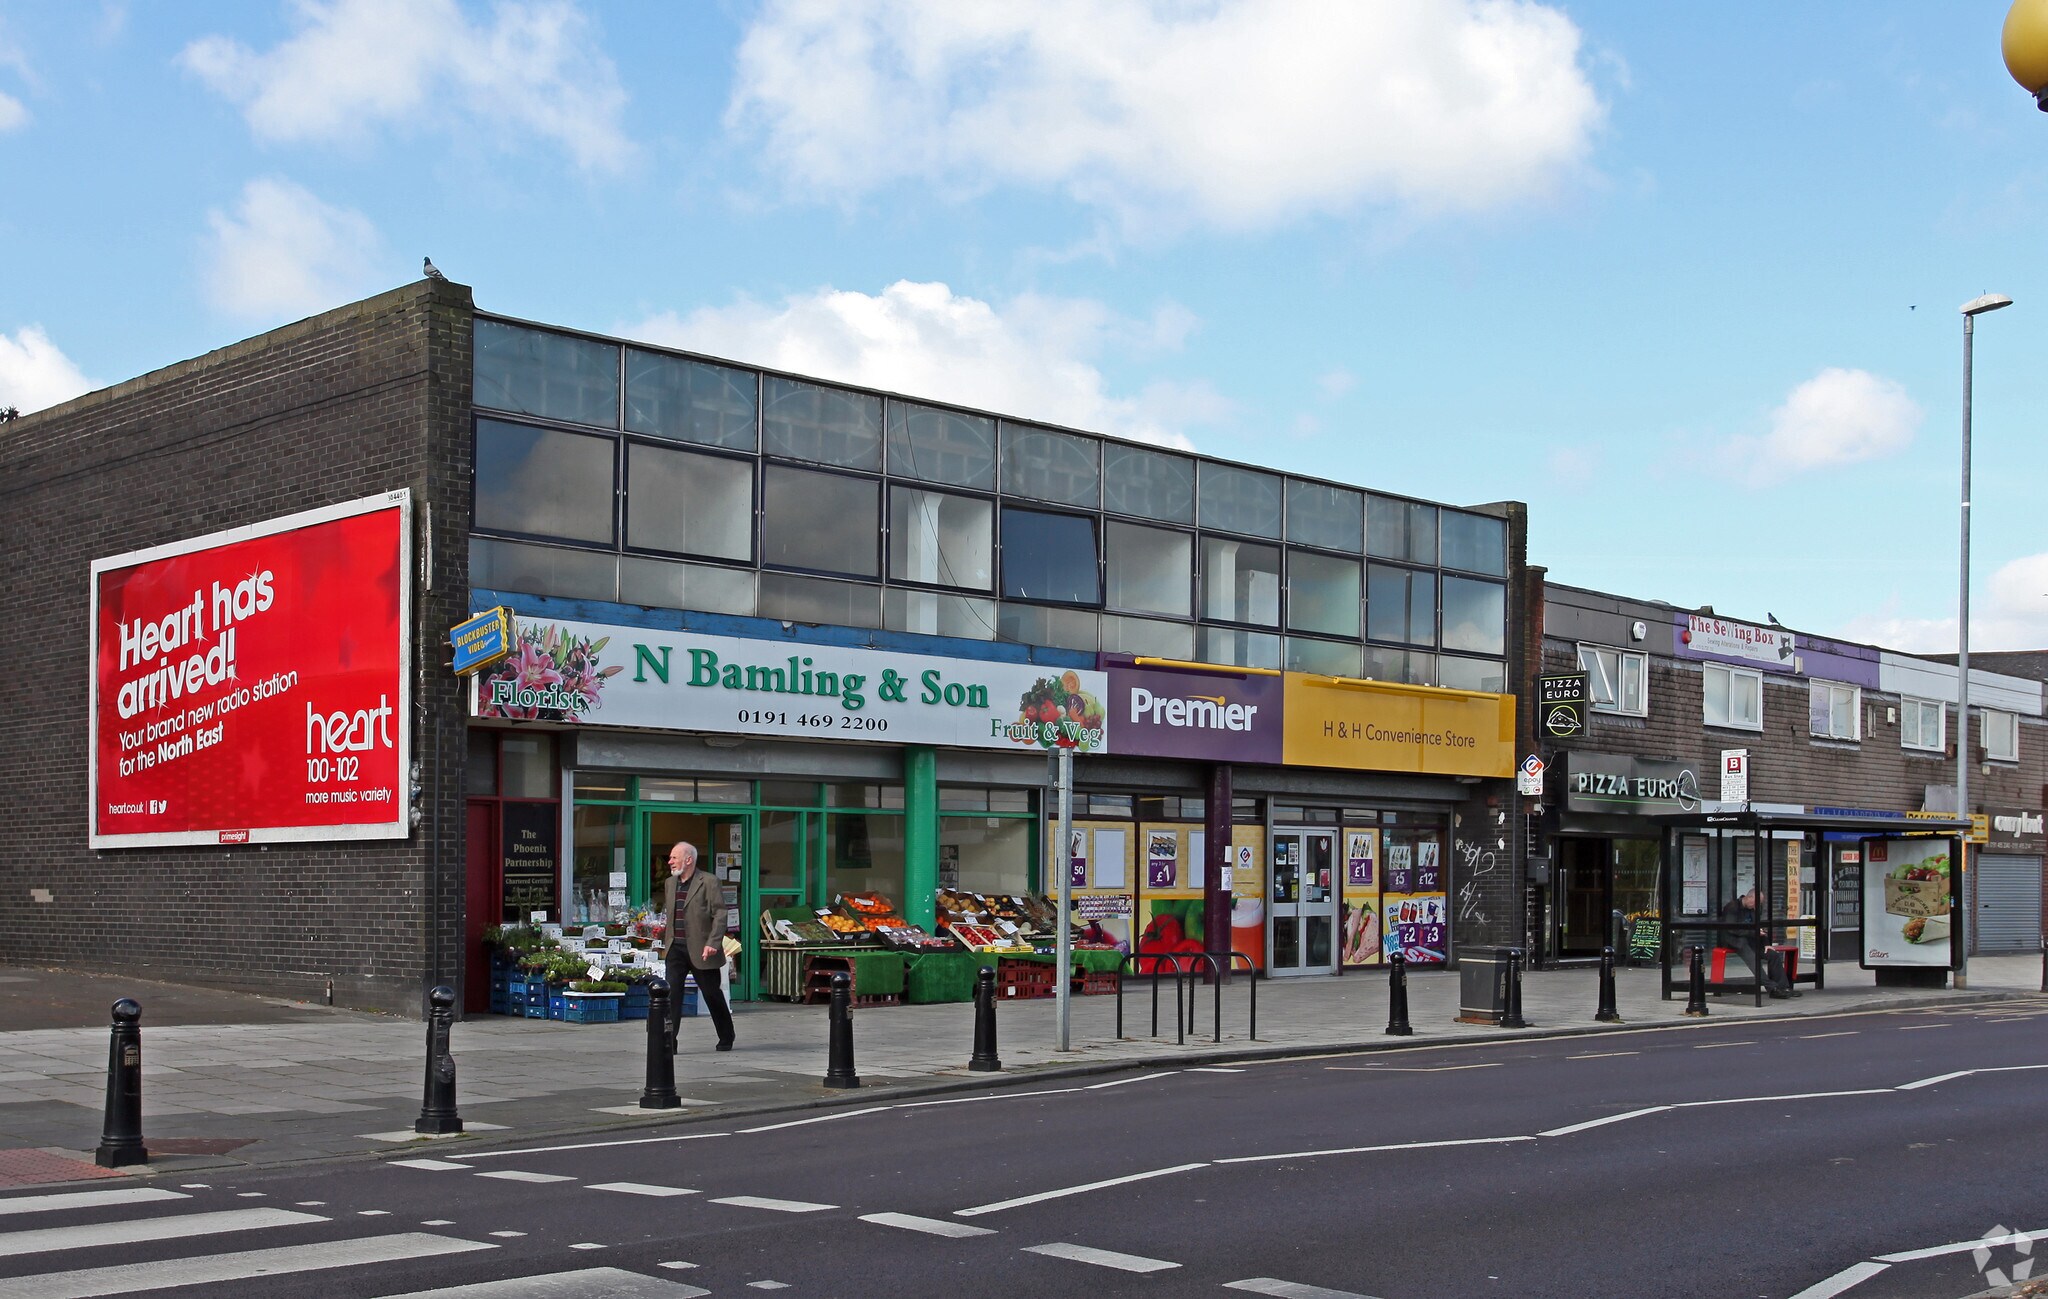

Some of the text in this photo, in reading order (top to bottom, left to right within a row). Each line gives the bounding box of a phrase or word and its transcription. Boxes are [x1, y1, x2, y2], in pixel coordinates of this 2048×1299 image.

[120, 570, 274, 671] Heart has
[1690, 615, 1710, 634] The
[1755, 628, 1774, 644] Box
[457, 620, 500, 647] BLOCKBUSTER
[468, 640, 485, 654] VIDEO
[118, 628, 236, 719] arrived!
[633, 644, 990, 711] N Bamling & Son
[1545, 678, 1581, 688] PIZZA
[492, 680, 583, 710] Florist
[1547, 689, 1580, 699] EURO
[120, 670, 298, 751] Your brand new radio station
[1130, 687, 1258, 732] Premier
[307, 694, 393, 754] heart
[738, 709, 888, 732] 0191 469 2200
[990, 718, 1100, 748] Fruit & Veg
[1324, 720, 1475, 748] H & H Convenience Store
[120, 724, 224, 777] for the North East
[307, 756, 359, 782] 100-102
[1730, 759, 1738, 768] B
[1579, 773, 1677, 798] PIZZA EURO
[306, 787, 392, 804] more music variety
[108, 802, 144, 814] heart.co.uk
[221, 831, 246, 842] primesight
[521, 830, 536, 839] The
[514, 844, 547, 853] Phoenix
[505, 858, 553, 868] Partnership
[1074, 866, 1084, 875] 50
[1354, 863, 1366, 877] £1
[1156, 864, 1170, 882] £1
[1396, 872, 1405, 885] £5
[1404, 927, 1415, 942] £2
[1427, 927, 1438, 942] £3
